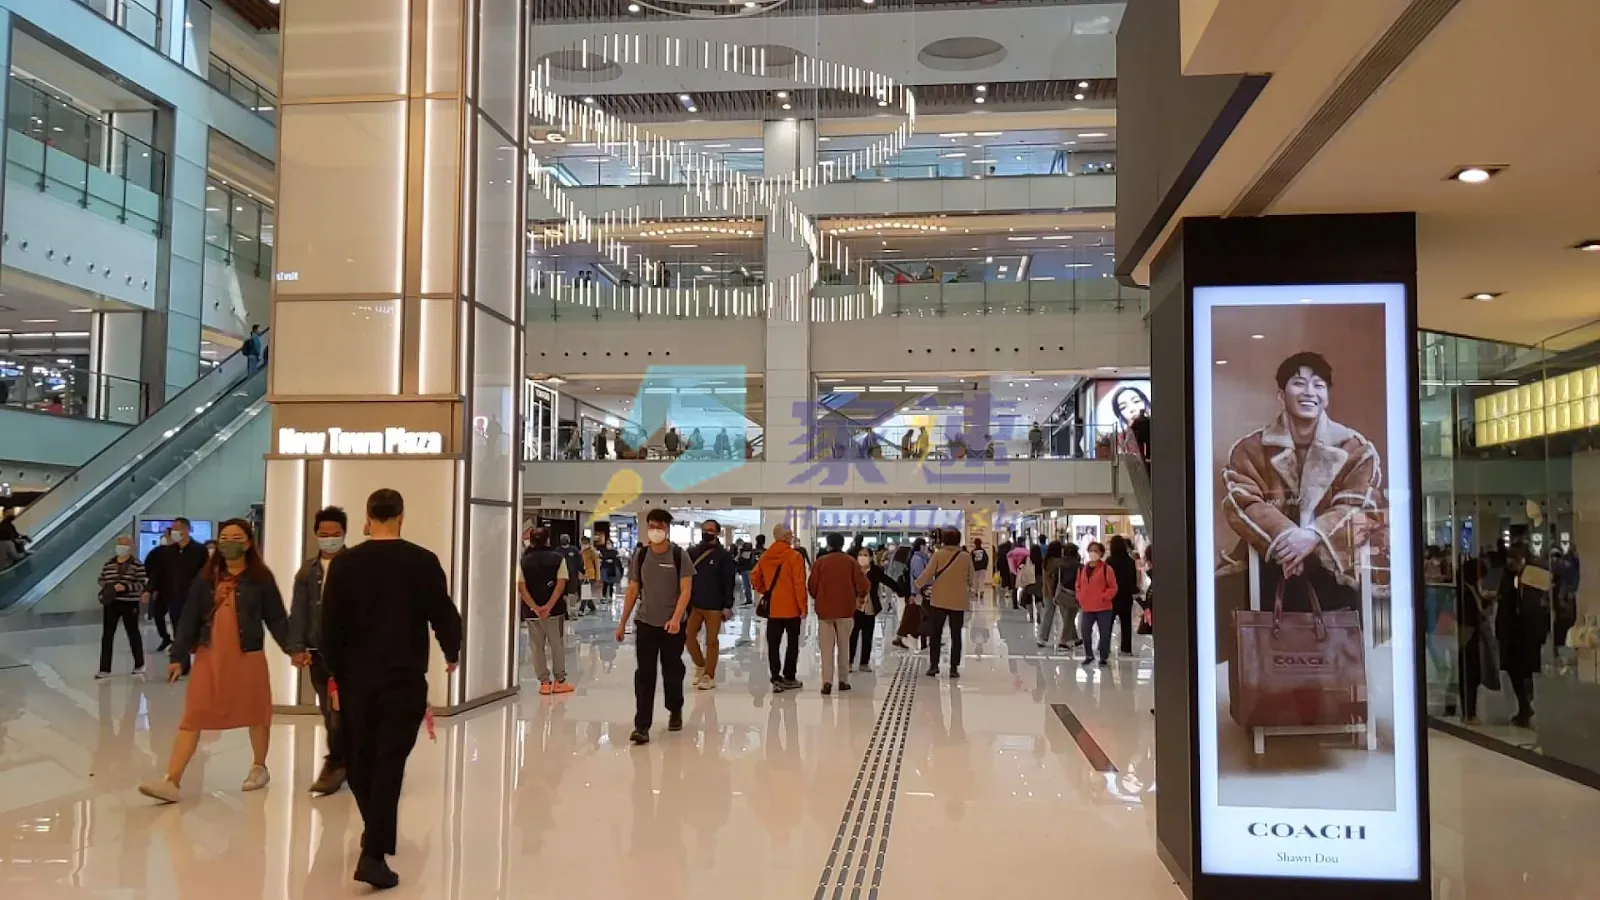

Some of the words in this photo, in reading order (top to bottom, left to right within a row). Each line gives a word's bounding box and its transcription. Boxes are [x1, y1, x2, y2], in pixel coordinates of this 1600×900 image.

[279, 428, 326, 454] New
[328, 427, 384, 454] Town
[385, 427, 442, 454] Plaza
[1248, 822, 1366, 840] COACH
[1276, 852, 1311, 863] Shawn
[1315, 853, 1339, 864] Dou
